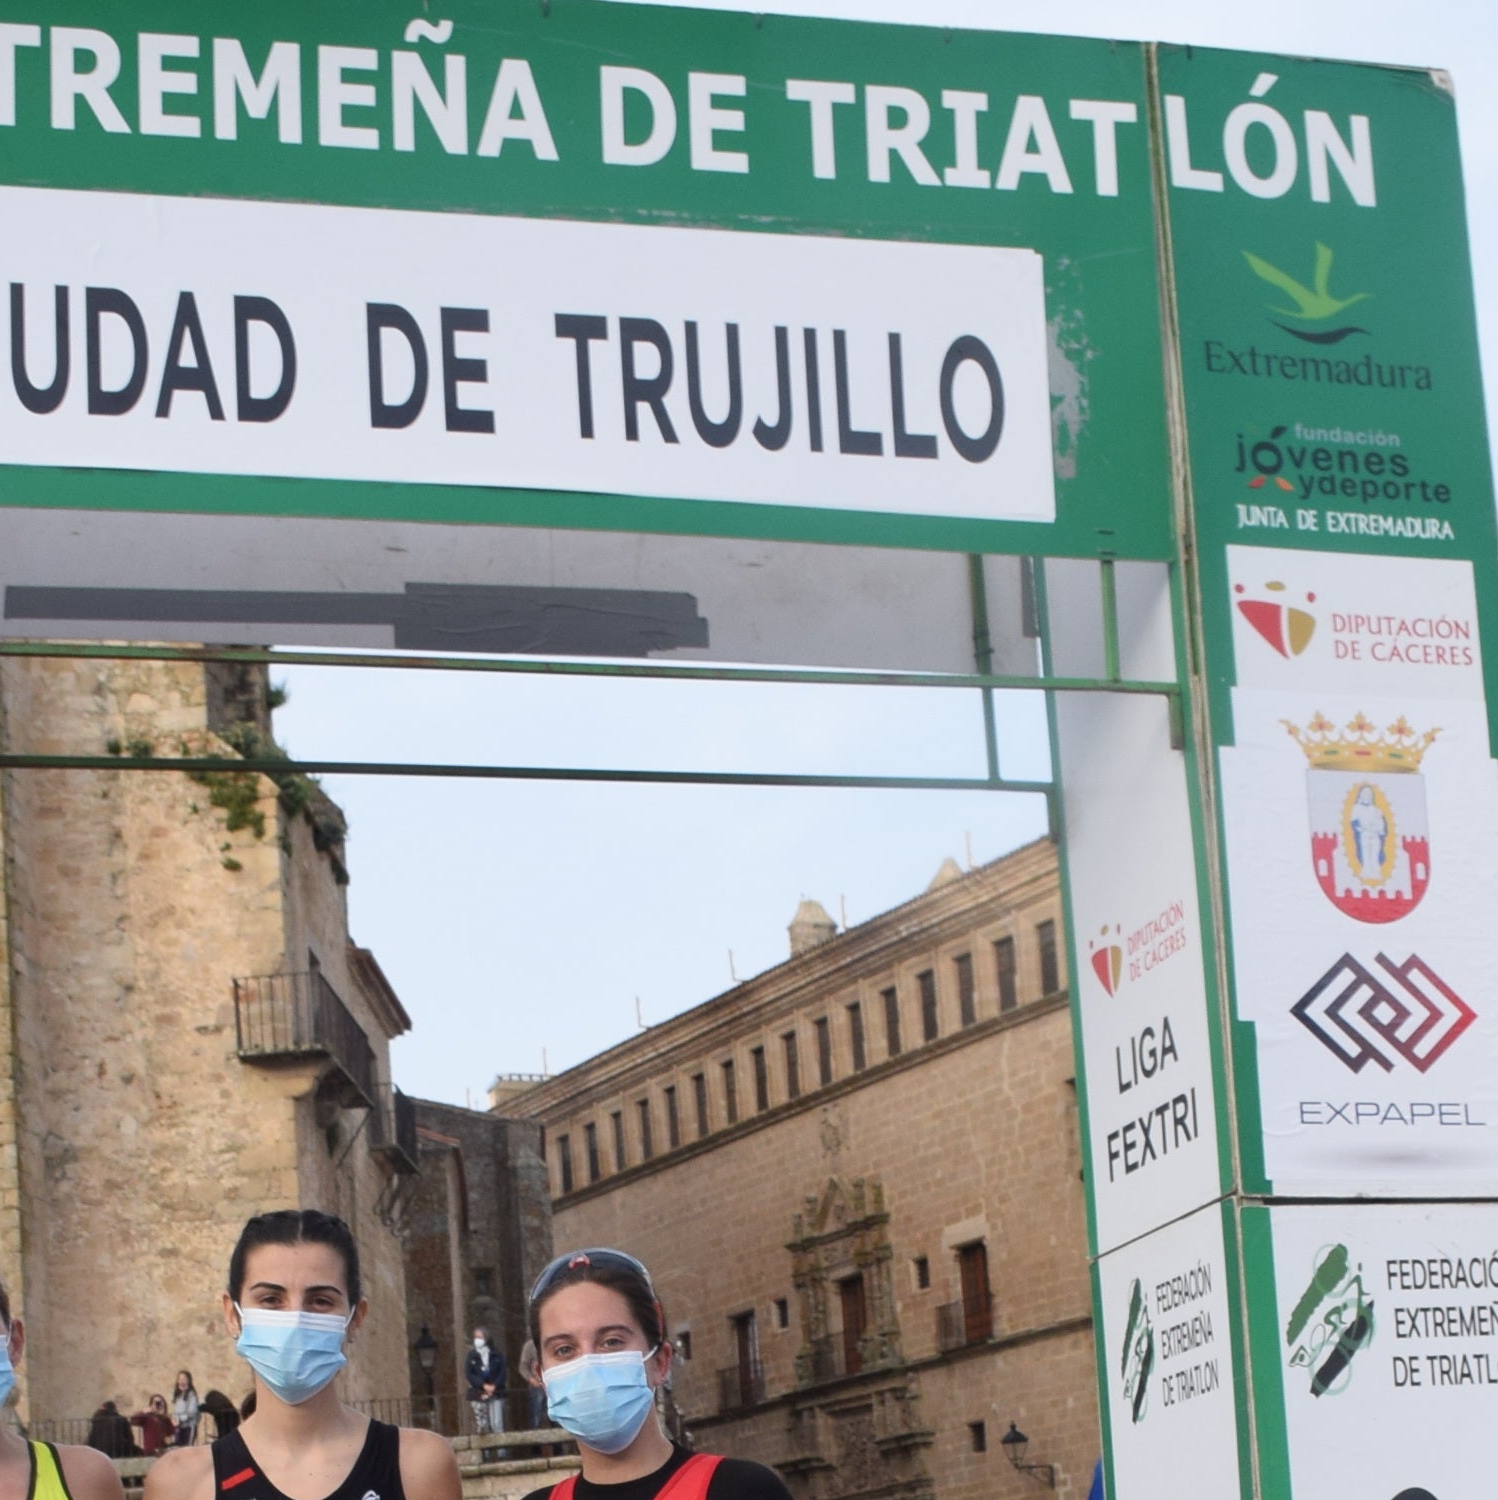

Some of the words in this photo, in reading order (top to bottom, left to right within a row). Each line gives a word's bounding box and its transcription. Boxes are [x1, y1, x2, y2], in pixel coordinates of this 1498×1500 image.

[600, 65, 750, 175] DE
[786, 74, 1376, 207] TRIATLÓN
[367, 302, 496, 435] DE
[554, 313, 1005, 464] TRUJILLO
[1204, 341, 1433, 390] Extremadura
[1235, 425, 1409, 477] jóvenes
[1294, 422, 1400, 447] fundación
[1298, 473, 1451, 503] ydeporte
[1236, 504, 1288, 529] JUNTA
[1297, 508, 1318, 532] DE
[1326, 511, 1454, 540] EXTREMADURA
[1332, 613, 1470, 641] DIPUTACIÓN
[1336, 641, 1361, 660] DE
[1372, 637, 1473, 666] CÁCERES
[1116, 1016, 1178, 1094] LIGA
[1300, 1101, 1487, 1126] EXPAPEL
[1108, 1087, 1198, 1183] FEXTRI
[1156, 1259, 1212, 1314] FEDERACIÓN
[1162, 1310, 1214, 1359] EXTREMEÑA
[1162, 1377, 1174, 1407] DE
[1393, 1356, 1421, 1386] DE
